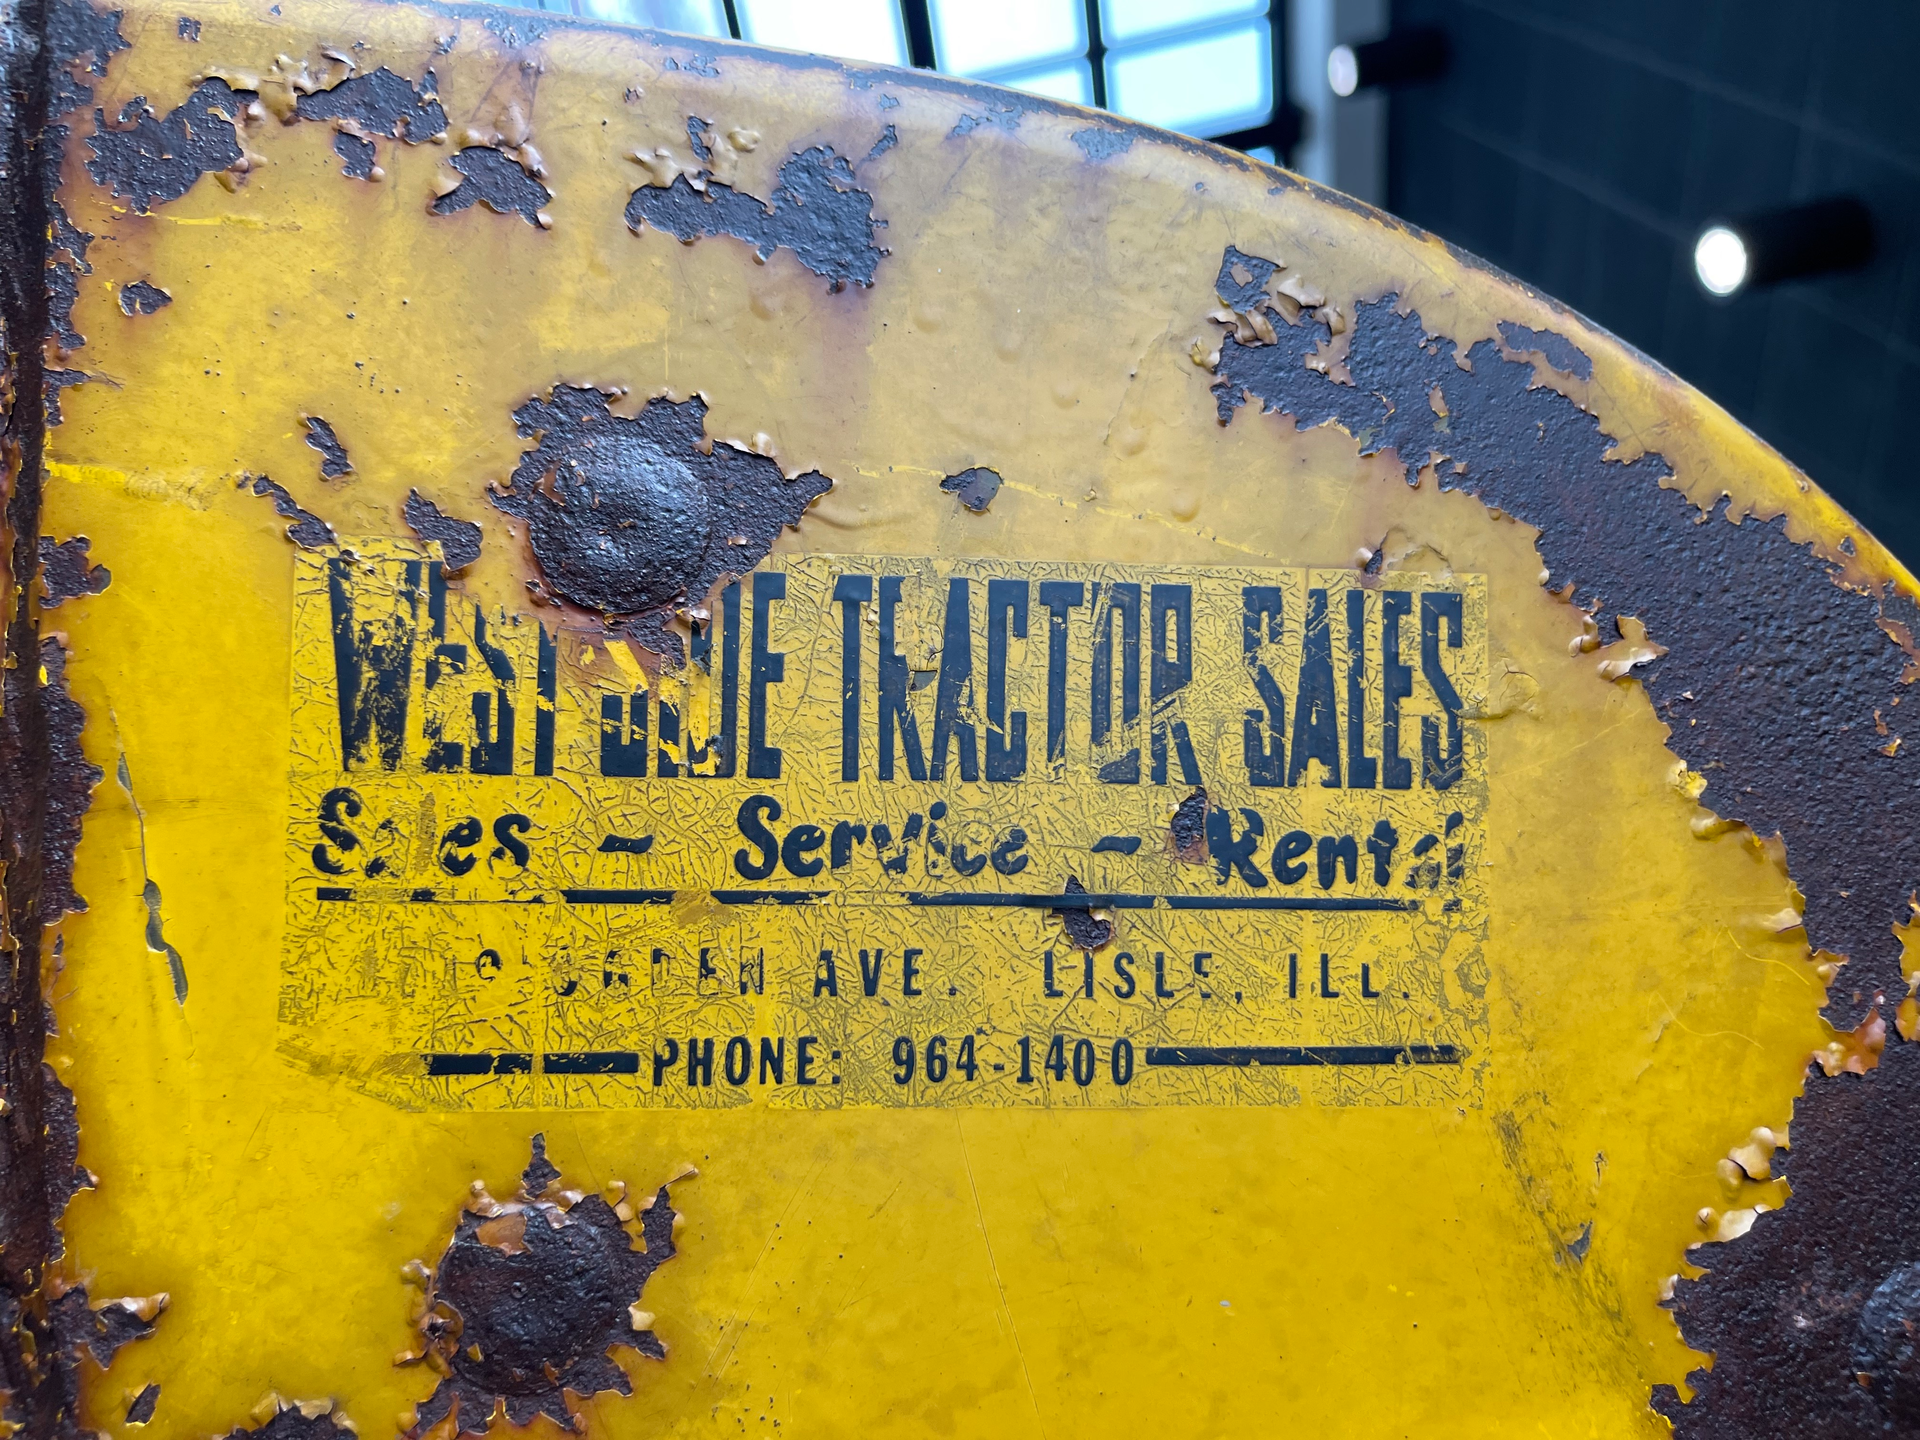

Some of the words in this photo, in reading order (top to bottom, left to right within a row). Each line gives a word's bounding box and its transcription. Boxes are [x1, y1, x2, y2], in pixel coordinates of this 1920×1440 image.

[832, 574, 1204, 786] TRACTOR
[1242, 585, 1465, 791] SALES
[733, 793, 1030, 881] Service
[653, 1036, 843, 1087] PHONE:
[892, 1034, 1135, 1087] 964-1400
